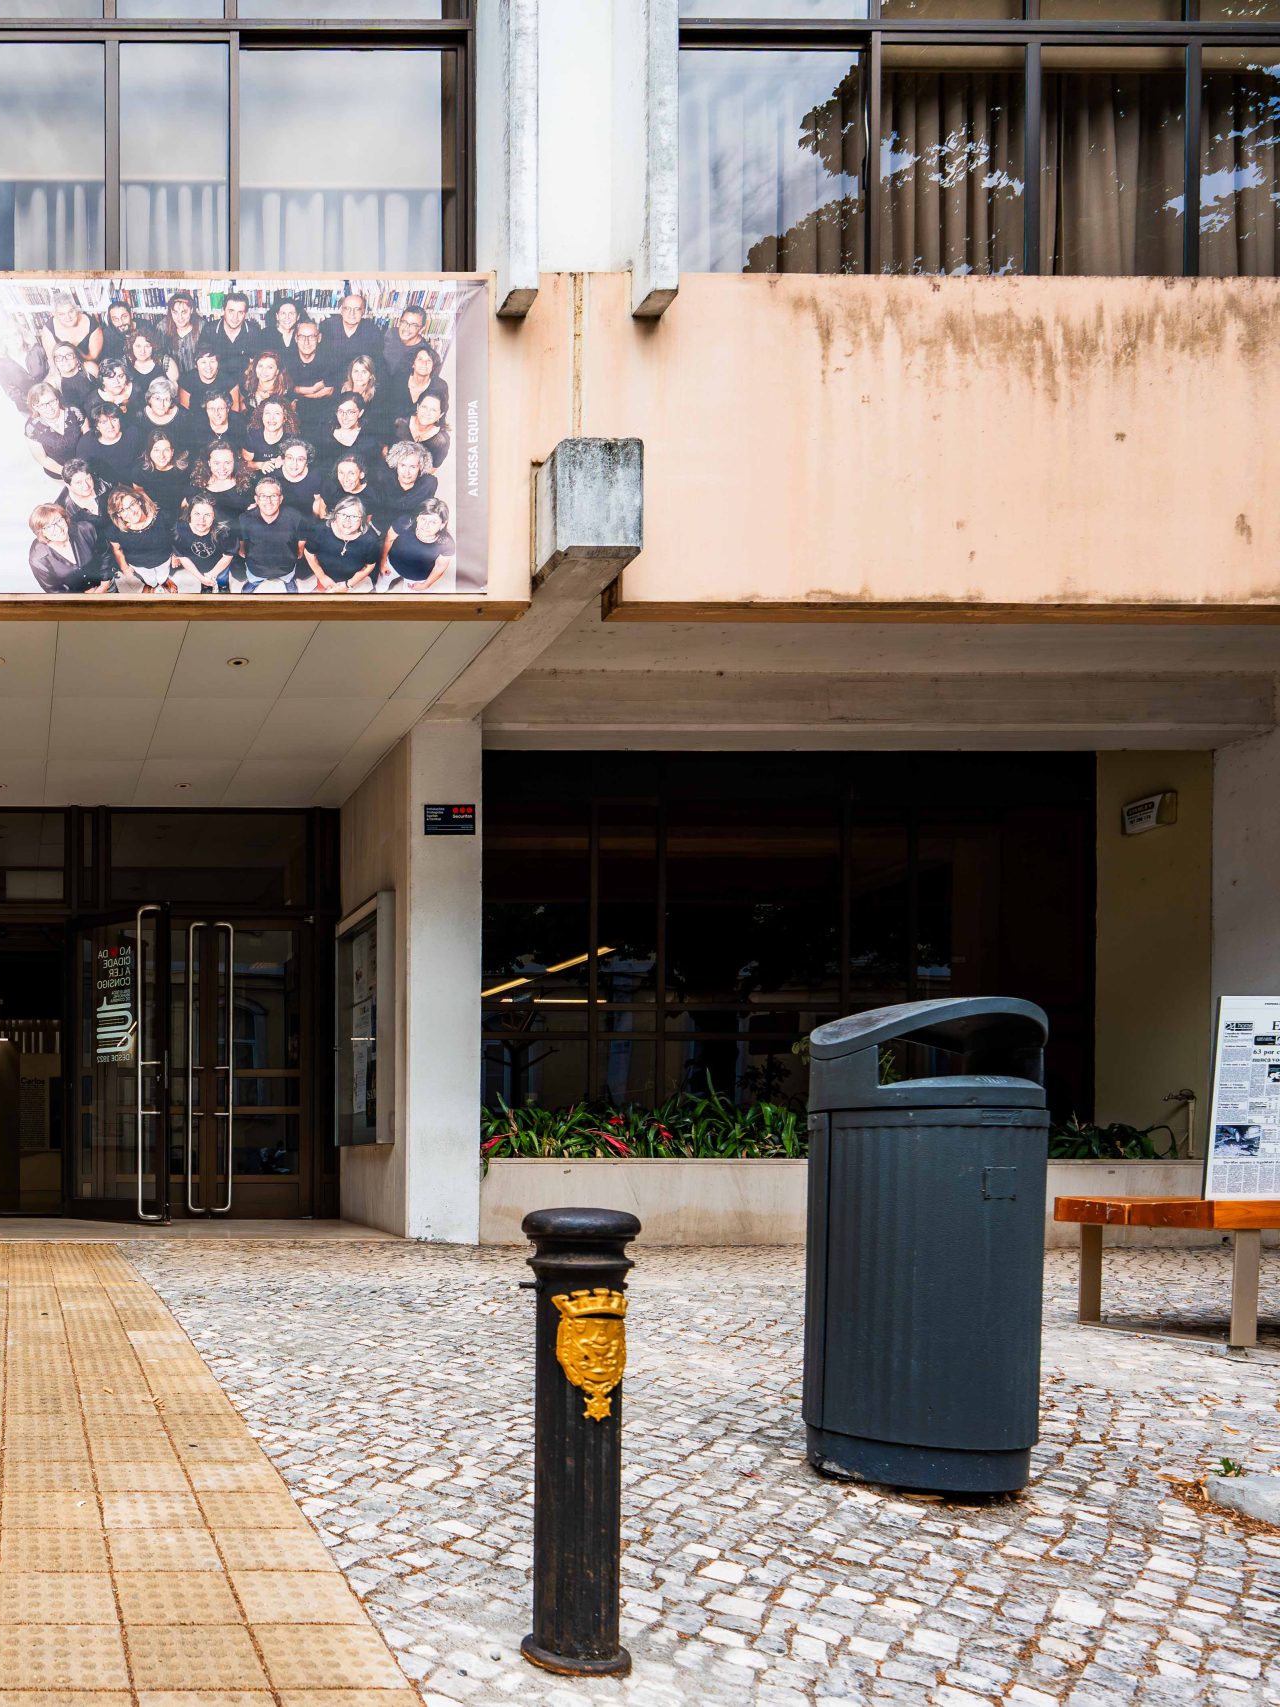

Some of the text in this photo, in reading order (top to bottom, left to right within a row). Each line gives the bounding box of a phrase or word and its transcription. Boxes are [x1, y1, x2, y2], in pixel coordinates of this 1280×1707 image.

[468, 399, 479, 497] A NOSSA EQUIPA
